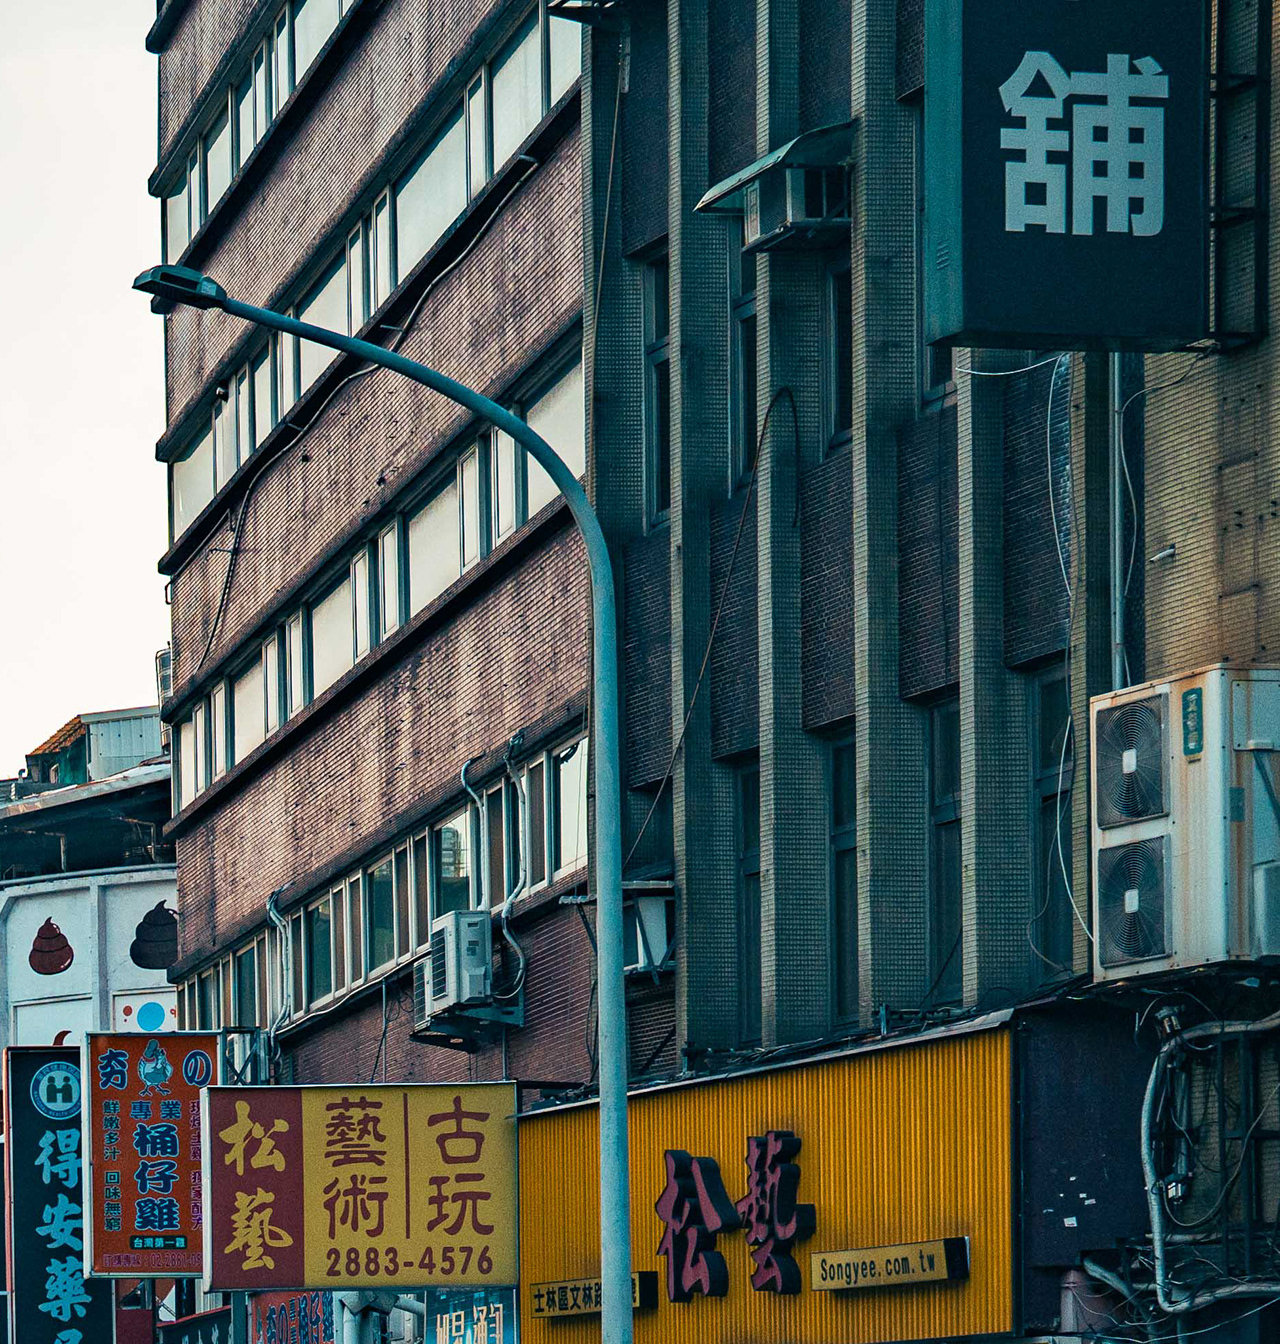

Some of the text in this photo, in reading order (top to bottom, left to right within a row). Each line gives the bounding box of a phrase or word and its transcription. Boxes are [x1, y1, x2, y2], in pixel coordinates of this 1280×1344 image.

[998, 51, 1170, 237] 舖
[133, 1123, 181, 1231] 桶仔雞
[323, 1096, 389, 1240] 藝術
[426, 1095, 494, 1238] 古玩
[325, 1245, 494, 1277] 2883-4576
[819, 1250, 937, 1285] Songyee.com.tw
